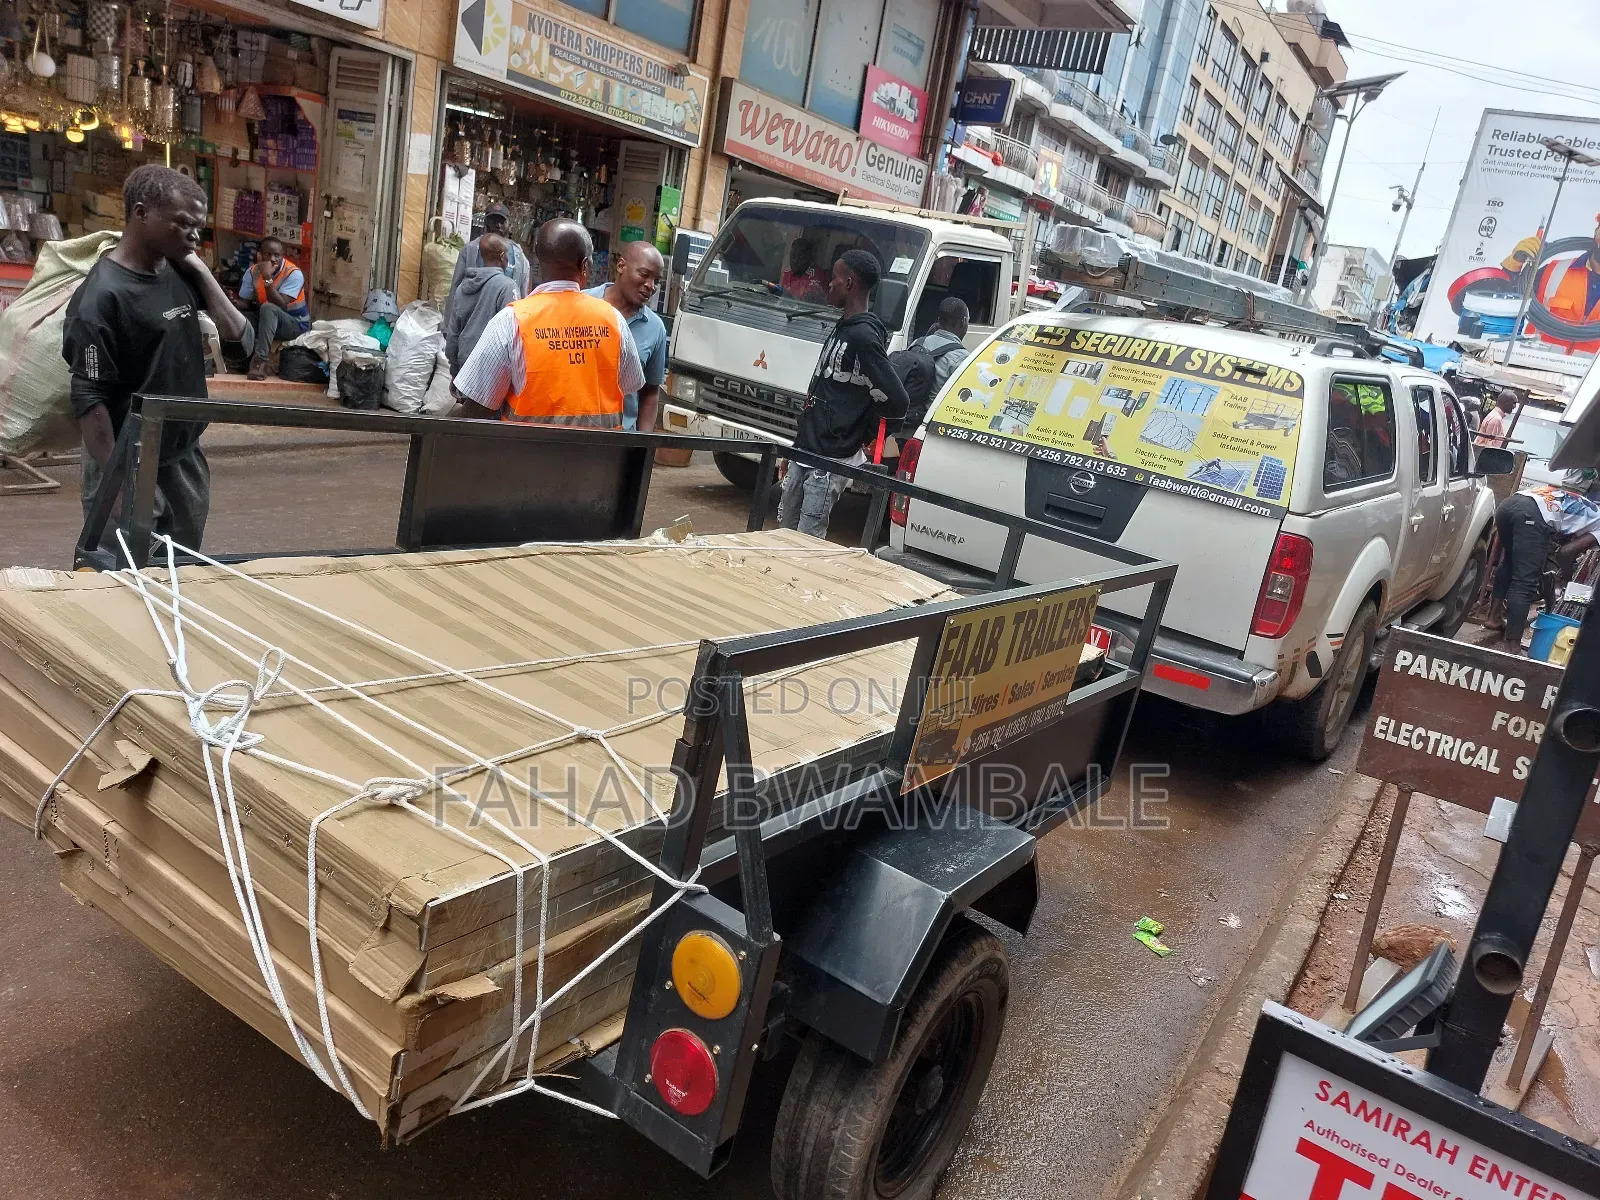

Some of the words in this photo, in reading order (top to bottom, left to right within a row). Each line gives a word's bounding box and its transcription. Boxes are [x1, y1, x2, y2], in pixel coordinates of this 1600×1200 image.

[527, 12, 582, 53] KYOTERA
[585, 36, 643, 74] SHOPPERS
[645, 60, 685, 91] CORNER
[554, 48, 581, 66] DEALERS
[581, 58, 588, 67] IN
[588, 60, 599, 73] ALL
[600, 64, 631, 84] ELECTRICAL
[631, 75, 661, 94] APPLIANCES
[872, 116, 911, 141] HIKVISION
[865, 142, 924, 185] Genuine
[1487, 144, 1542, 161] Trusted
[1480, 167, 1529, 177] uninterrupted
[862, 170, 885, 188] Electrical
[886, 179, 902, 196] Supply
[903, 185, 920, 199] Centre
[549, 339, 601, 350] SECURITY
[1023, 357, 1041, 366] Garage
[1071, 331, 1183, 369] SECURITY
[1185, 349, 1302, 392] SYSTEMS
[1111, 365, 1140, 375] Biometric
[1141, 371, 1162, 380] Access
[1108, 372, 1130, 381] Control
[1130, 375, 1157, 386] Systems
[713, 376, 804, 409] CANTER
[1230, 394, 1248, 403] FAAB
[945, 405, 961, 415] CCTV
[1223, 401, 1247, 411] Trailers
[951, 416, 973, 426] Systems
[1025, 432, 1050, 442] Intercom
[1050, 437, 1075, 448] Systems
[1036, 426, 1052, 435] Audio
[1059, 430, 1075, 439] Video
[1212, 431, 1229, 440] Solar
[1230, 436, 1249, 446] panel
[1256, 440, 1277, 451] Power
[946, 429, 969, 440] +256
[970, 433, 988, 445] 742
[990, 437, 1007, 449] 521
[1009, 441, 1028, 453] 727
[1036, 449, 1061, 462] +256
[1063, 454, 1083, 466] 782
[1085, 460, 1104, 471] 413
[1107, 465, 1127, 477] 635
[1135, 448, 1158, 460] Electric
[1159, 454, 1184, 466] Fencing
[1219, 442, 1259, 457] Installations
[1141, 459, 1167, 471] Systems
[1149, 474, 1271, 517] faabweld@gmail.com
[934, 615, 1005, 689] FAAB
[1004, 594, 1099, 667] TRAILERS
[1393, 649, 1526, 702] PARKING
[968, 692, 1000, 718] Hires
[1008, 679, 1036, 706] Sales
[1041, 664, 1075, 691] Service
[1491, 711, 1545, 745] FOR
[1373, 715, 1500, 775] ELECTRICAL
[1315, 1080, 1460, 1166] SAMIRAH
[1303, 1119, 1391, 1171] Authorised
[1394, 1164, 1453, 1199] Dealer
